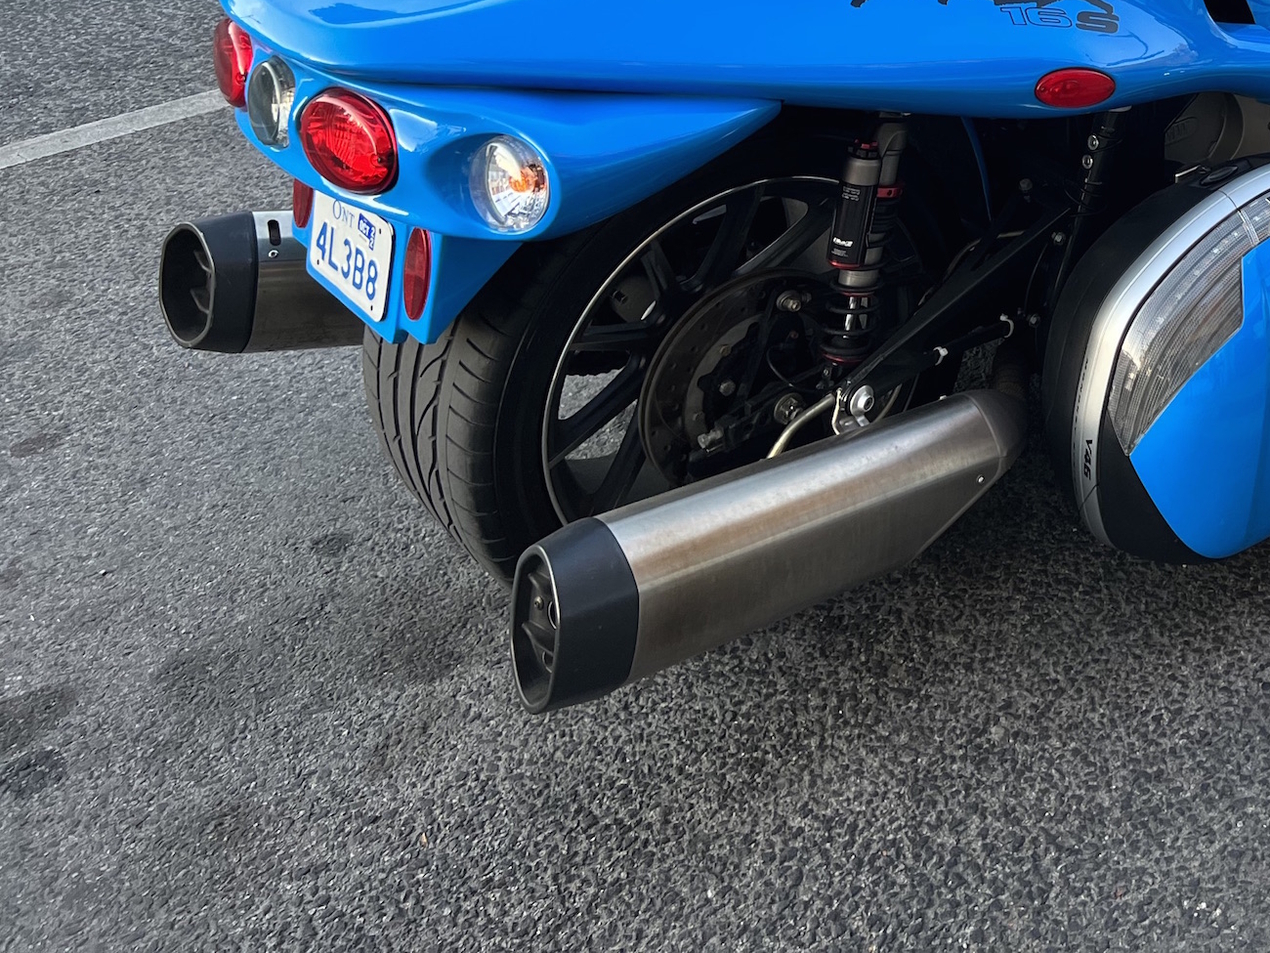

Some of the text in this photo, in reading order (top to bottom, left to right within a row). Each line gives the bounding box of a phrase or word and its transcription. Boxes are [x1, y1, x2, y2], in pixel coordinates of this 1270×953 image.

[999, 5, 1119, 34] 16S
[333, 199, 355, 229] ONT
[316, 221, 378, 301] 4L3B8
[1083, 439, 1093, 481] V46
